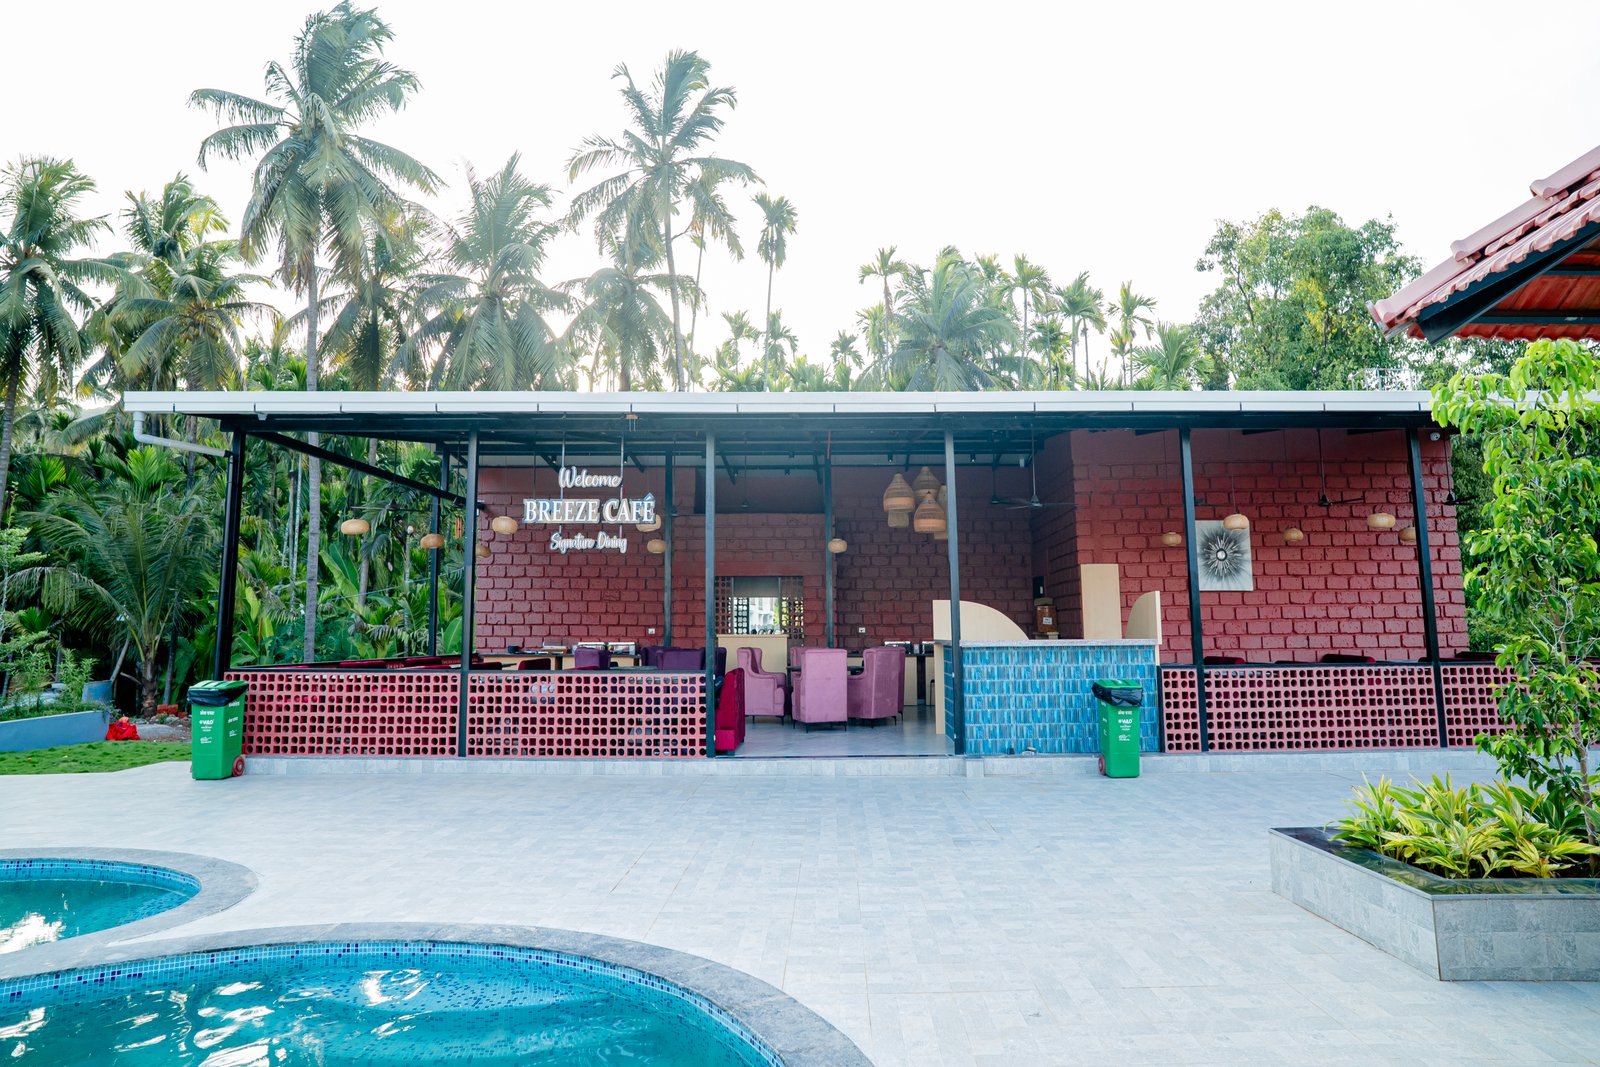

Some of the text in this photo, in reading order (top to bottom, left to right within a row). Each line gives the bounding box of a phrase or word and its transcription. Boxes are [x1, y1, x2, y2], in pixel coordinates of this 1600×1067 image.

[558, 466, 622, 488] Welcome
[523, 493, 655, 523] BREEZE CAFÉ
[550, 531, 627, 553] Signature Dining
